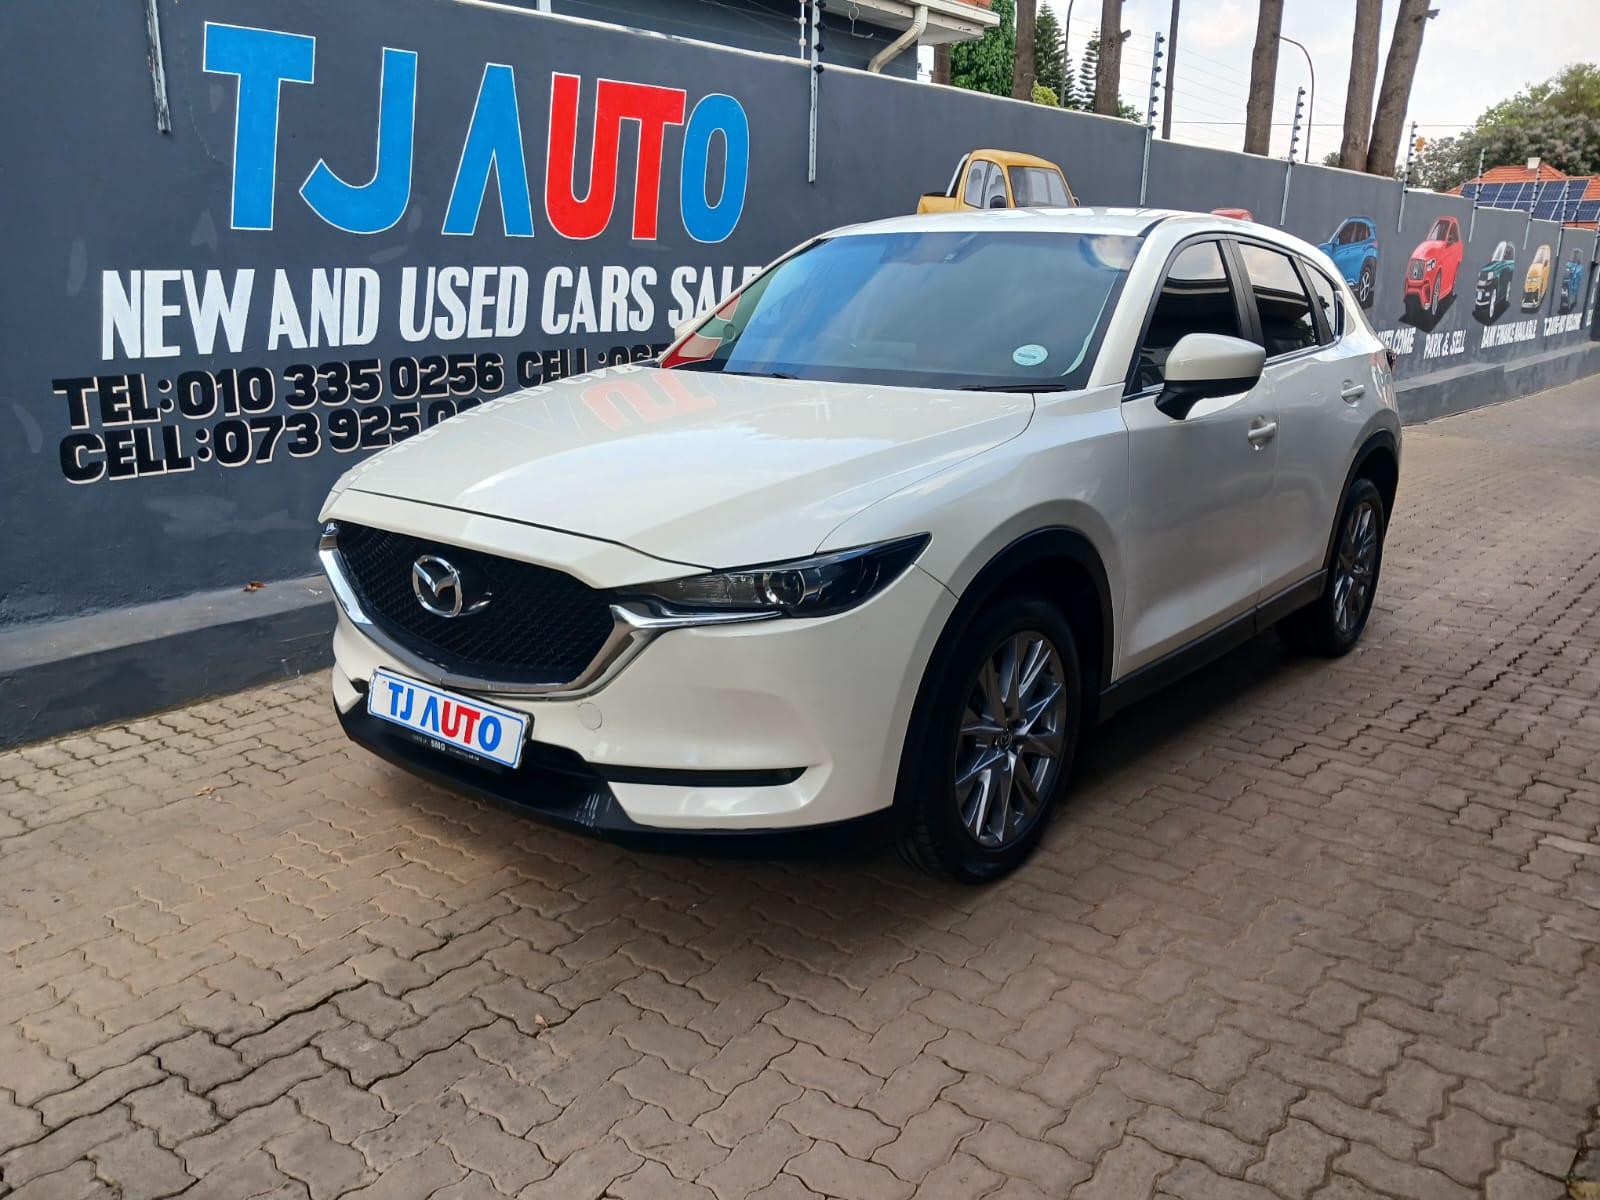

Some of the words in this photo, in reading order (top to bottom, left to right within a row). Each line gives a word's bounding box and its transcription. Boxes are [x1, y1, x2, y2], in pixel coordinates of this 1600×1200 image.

[203, 21, 418, 234] TJ
[441, 62, 750, 243] AUTO
[102, 268, 255, 360] NEW
[267, 267, 381, 350] AND
[399, 266, 529, 342] USED
[541, 266, 657, 335] CARS
[1423, 333, 1444, 360] PARK
[1441, 332, 1450, 357] &
[1449, 330, 1467, 355] SELL
[52, 366, 277, 430] TEL:010
[283, 359, 383, 410] 335
[389, 352, 505, 400] 0256
[60, 411, 322, 485] CELL:073
[328, 402, 422, 453] 925
[388, 681, 415, 721] TJ
[420, 695, 502, 752] AUTO
